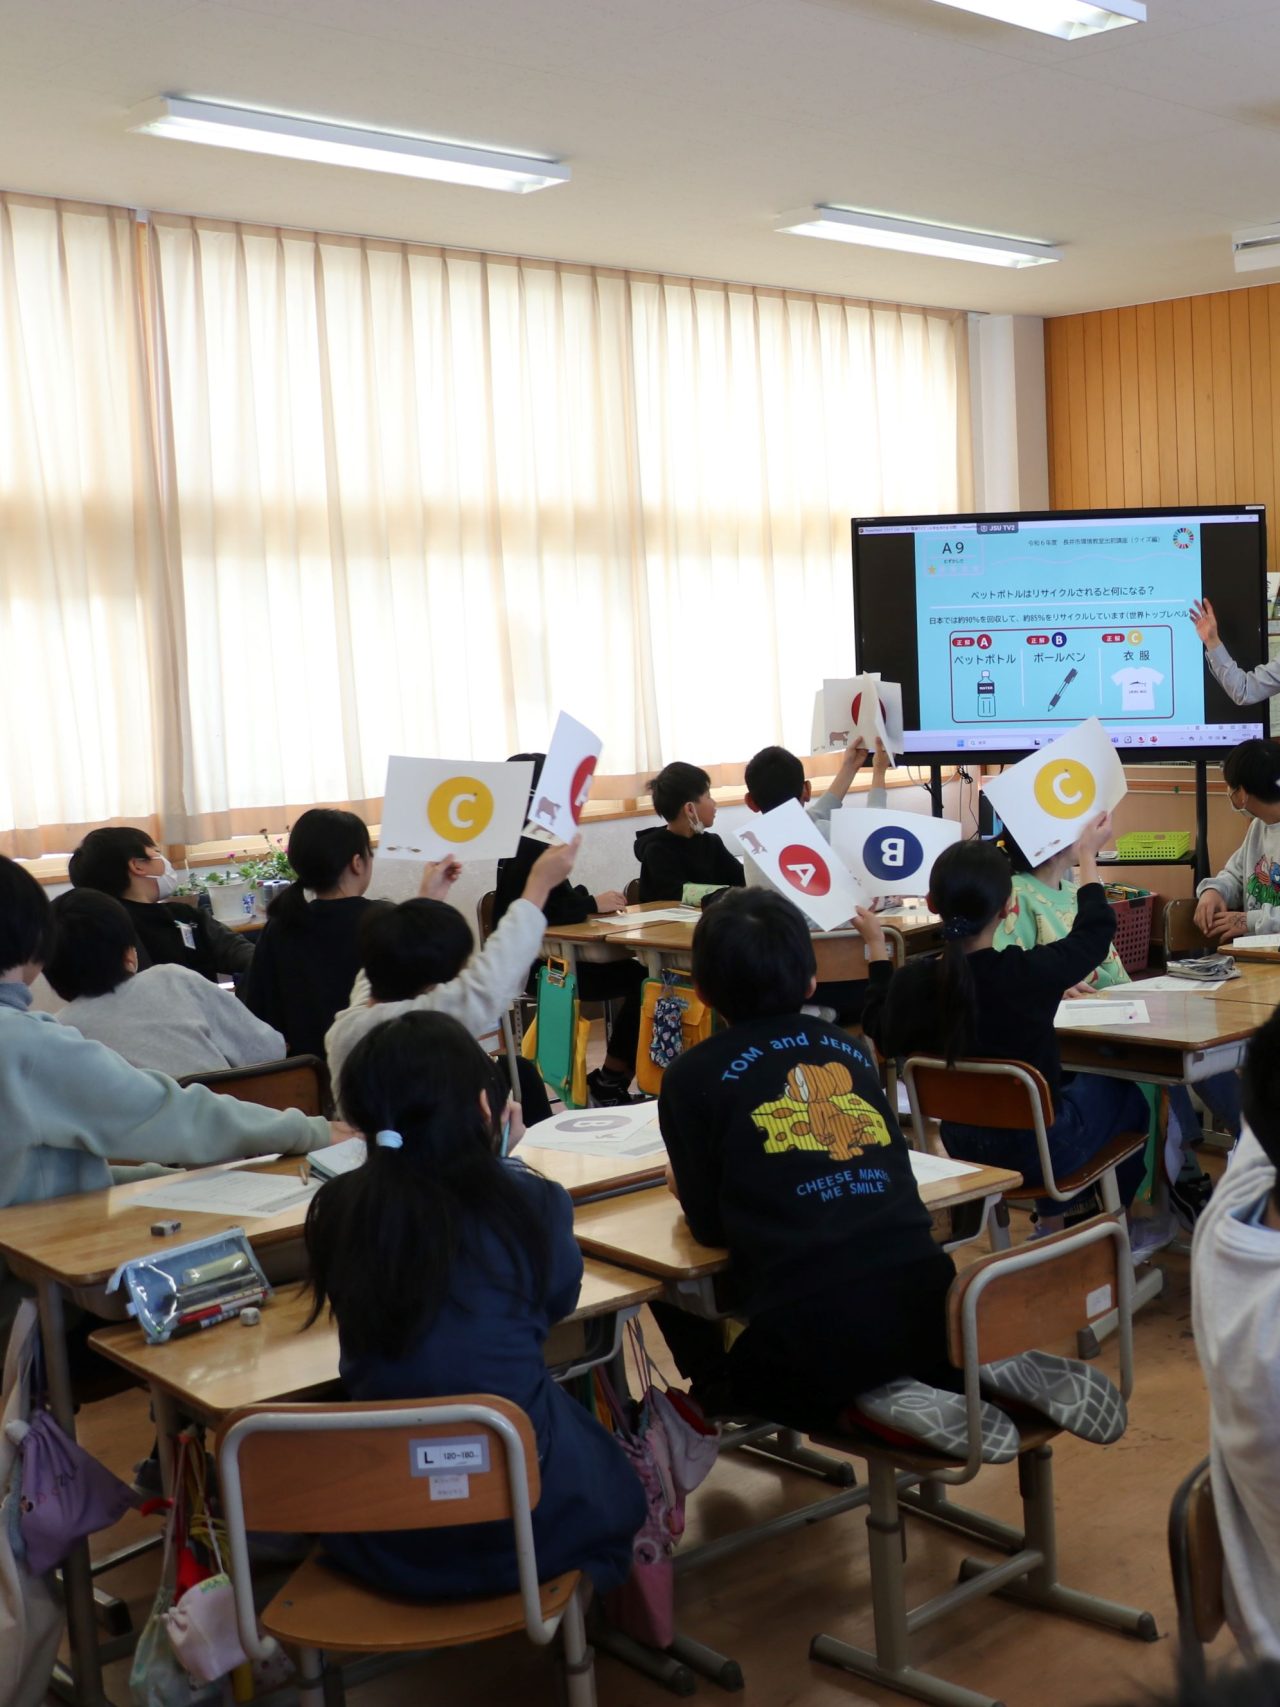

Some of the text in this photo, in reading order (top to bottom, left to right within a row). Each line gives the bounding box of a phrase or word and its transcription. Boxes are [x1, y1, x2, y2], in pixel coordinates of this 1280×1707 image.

[980, 638, 988, 646] A
[1055, 635, 1063, 644] B
[1131, 633, 1139, 642] C
[954, 654, 1016, 665] ペットボトル
[1034, 652, 1086, 663] ボールペン
[1053, 771, 1083, 805] C
[448, 793, 478, 829] C
[881, 837, 905, 867] B
[787, 863, 816, 888] A
[721, 1032, 873, 1082] TOM and JERRY
[573, 1120, 614, 1128] B
[796, 1170, 853, 1197] CHEESE
[820, 1181, 886, 1202] ME SMILE
[424, 1451, 435, 1465] L
